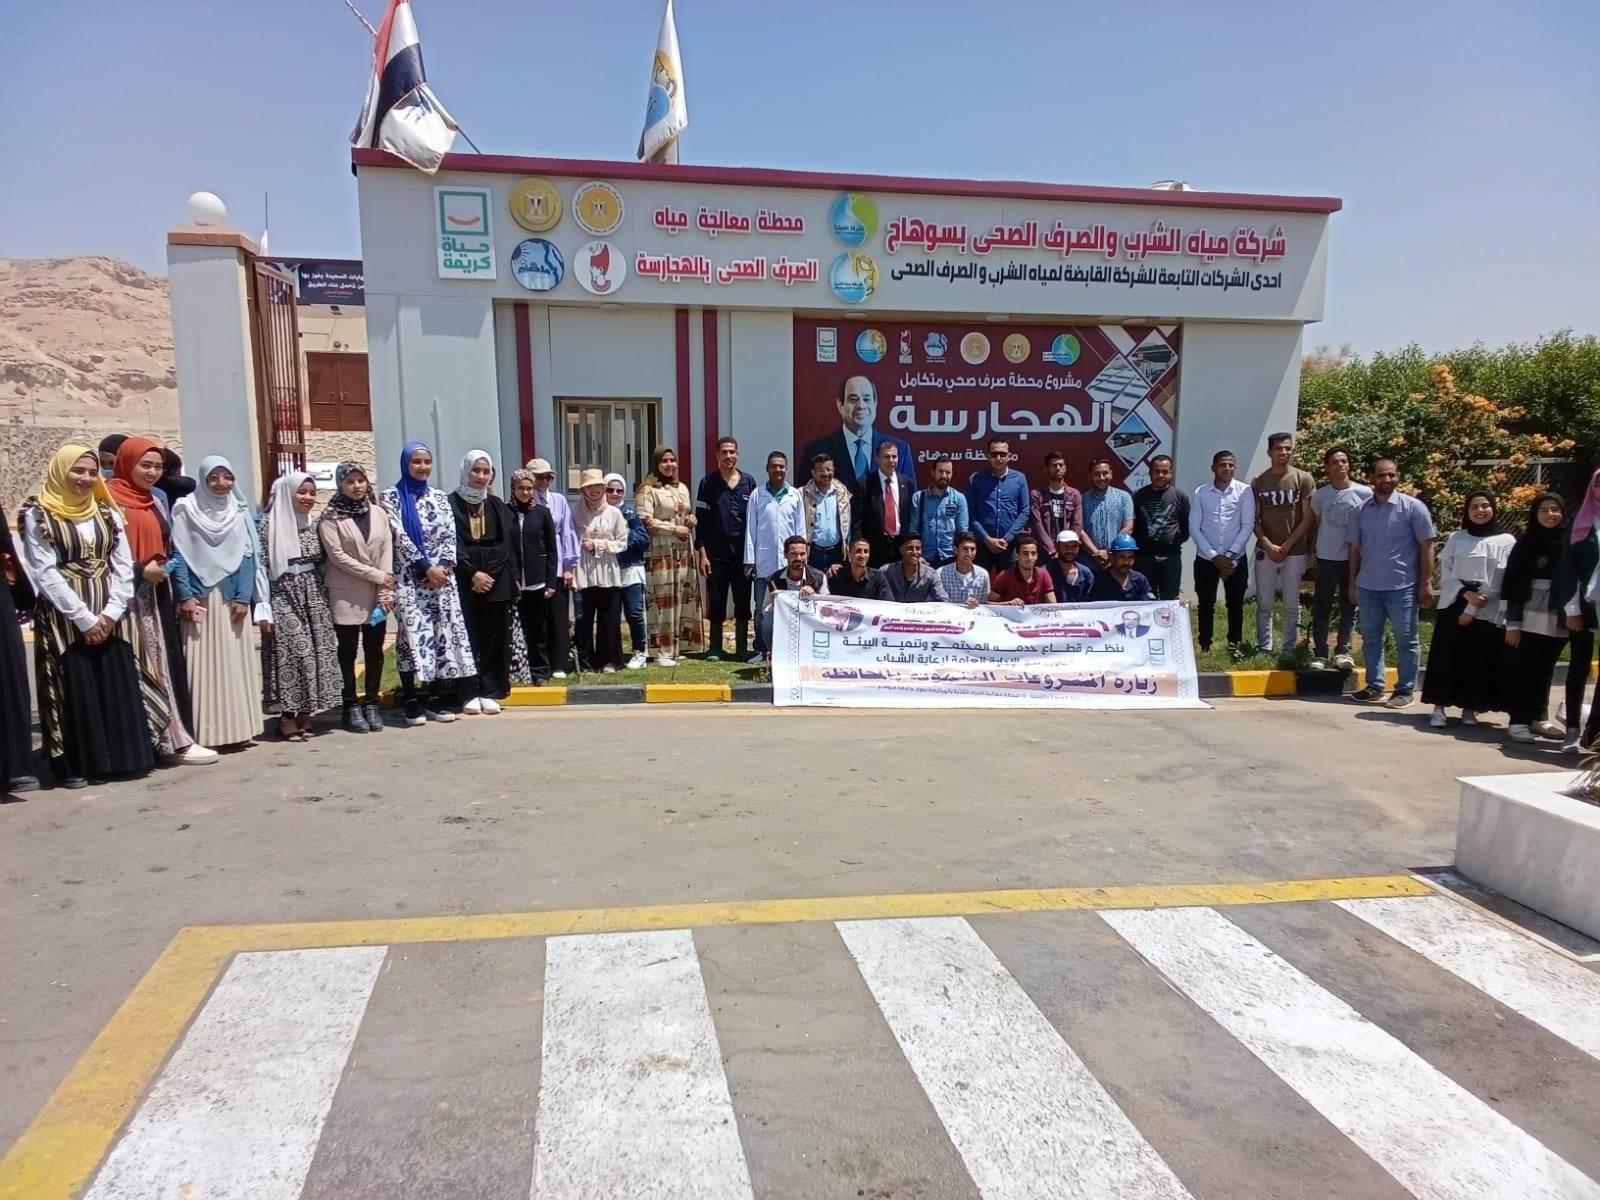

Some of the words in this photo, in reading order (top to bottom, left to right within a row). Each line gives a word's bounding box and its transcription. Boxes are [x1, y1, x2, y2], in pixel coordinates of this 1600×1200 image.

[654, 206, 688, 234] مياه
[698, 207, 750, 235] معالجة
[757, 209, 804, 233] محطة
[441, 235, 490, 257] حياة
[887, 216, 967, 252] بسوهاج
[972, 221, 1038, 254] الصحى
[1043, 220, 1118, 258] والصرف
[1123, 221, 1182, 259] الشرب
[1187, 230, 1229, 262] مياه
[1234, 226, 1286, 263] شركة
[442, 253, 492, 274] كريمة
[636, 253, 711, 284] بالهجارسة
[717, 255, 765, 282] الصحى
[772, 256, 818, 285] الصرف
[890, 259, 934, 281] الصحى
[936, 259, 987, 285] والصرف
[988, 260, 1027, 288] الشرب
[1028, 263, 1063, 286] لمياه
[1064, 263, 1112, 287] القابضة
[1113, 264, 1157, 289] للشركة
[1158, 268, 1200, 291] التابعة
[1200, 267, 1249, 291] الشركات
[1250, 272, 1282, 291] احدى
[899, 371, 943, 389] متكامل
[944, 375, 976, 393] صحي
[978, 372, 1007, 390] صرف
[1008, 372, 1043, 389] محطة
[1044, 371, 1082, 390] مشروع
[888, 395, 1112, 440] الهجارسة
[964, 448, 1019, 462] مظة
[842, 636, 878, 650] البيئة
[881, 637, 928, 651] وتنمية
[931, 639, 990, 653] المجتمع
[1113, 673, 1159, 695] زيارة
